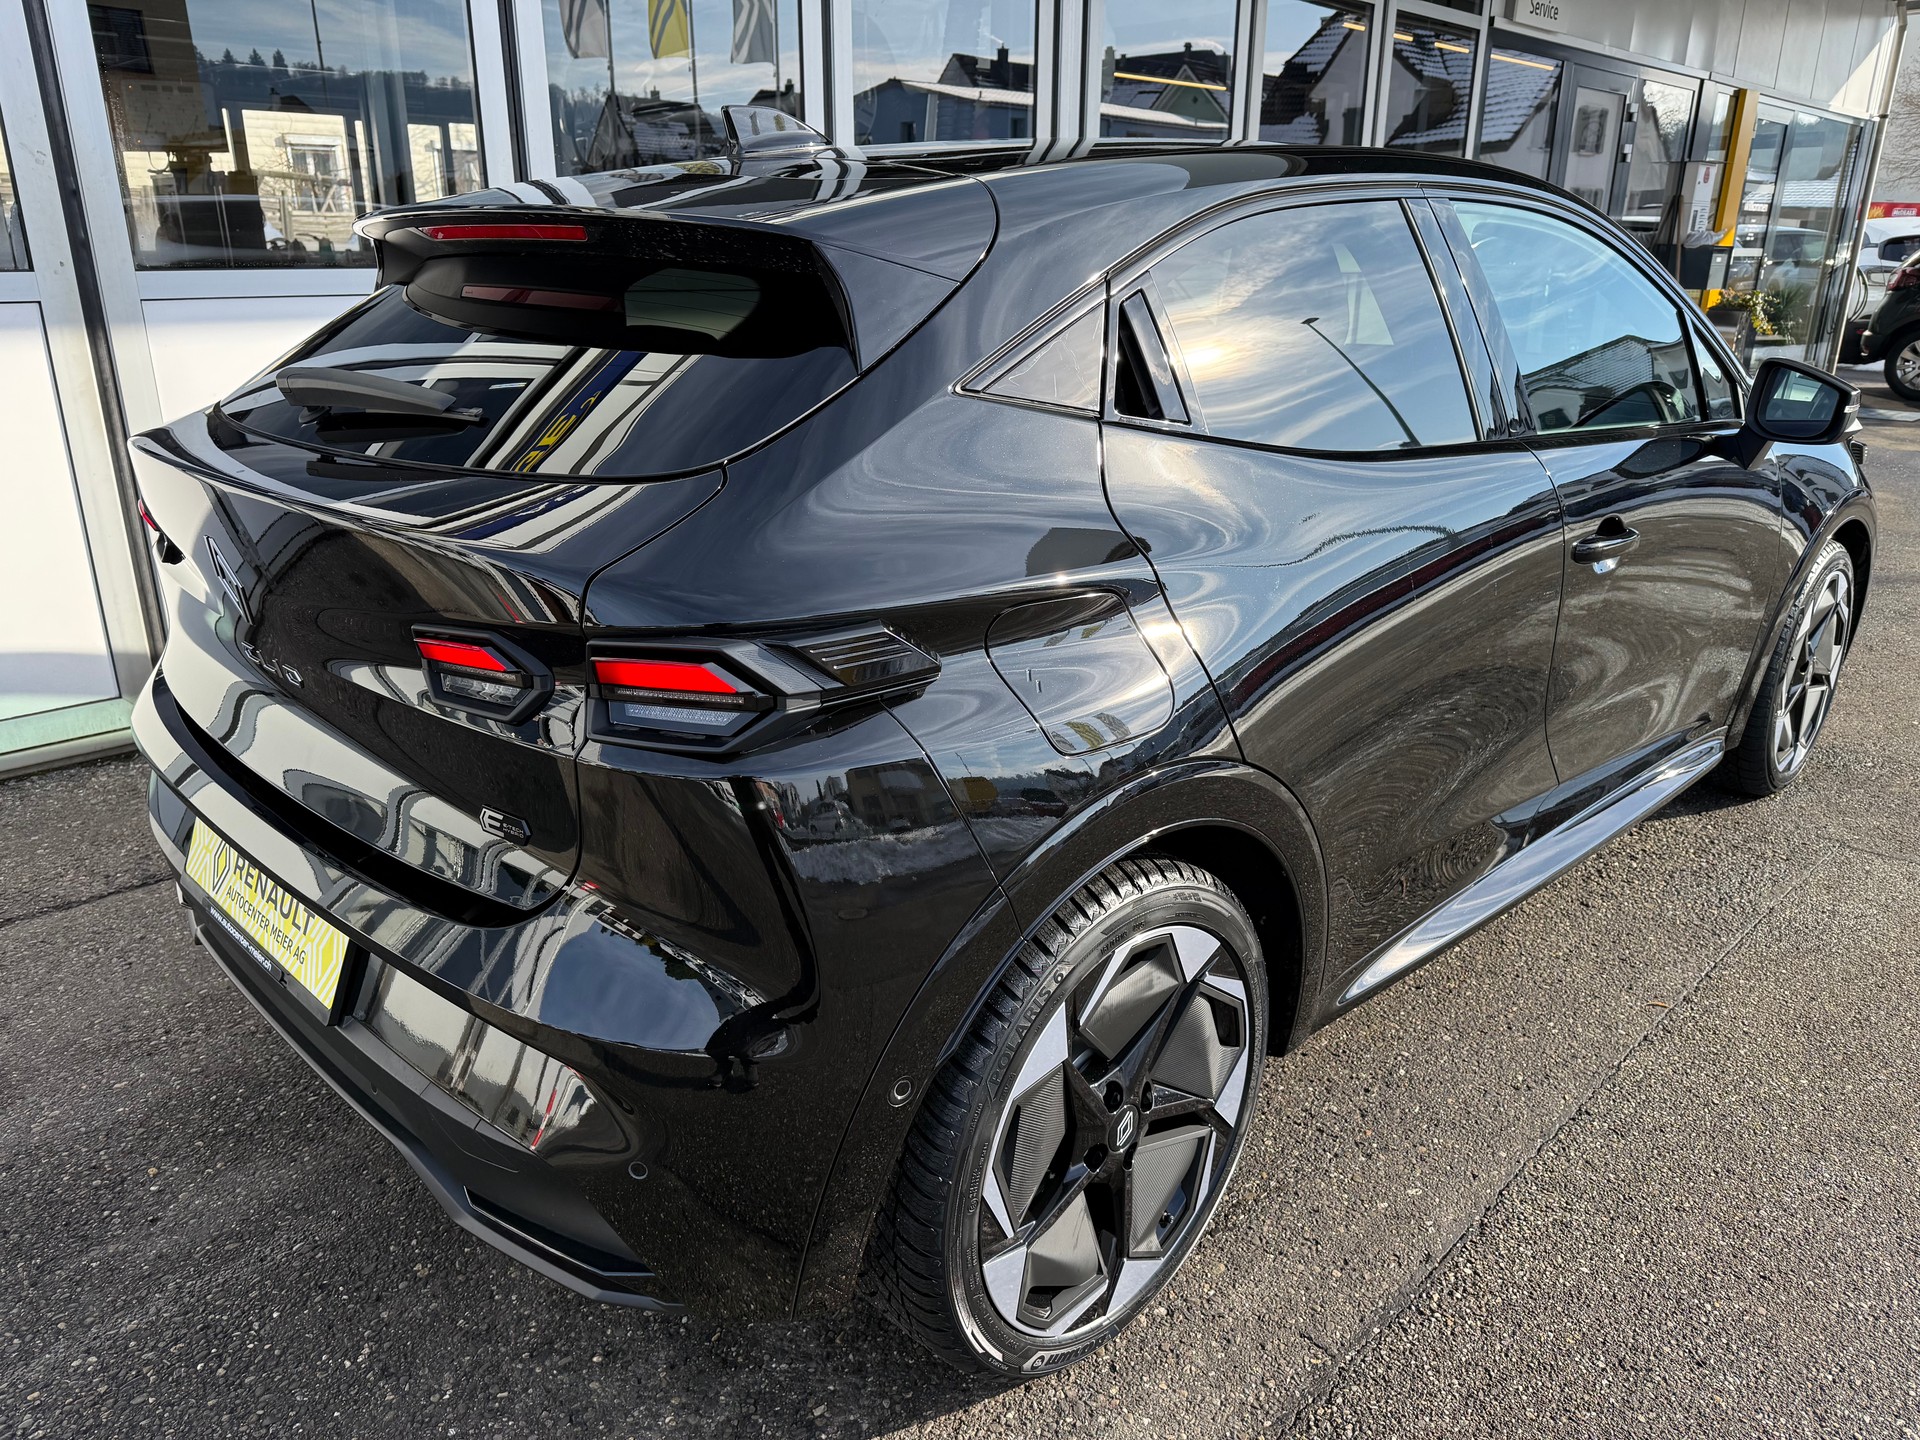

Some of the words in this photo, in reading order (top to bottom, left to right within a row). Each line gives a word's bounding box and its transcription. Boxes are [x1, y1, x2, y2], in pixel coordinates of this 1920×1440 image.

[1529, 0, 1559, 20] Service
[226, 885, 271, 930] AUTOCENTER
[270, 924, 294, 955] MEIER
[293, 945, 307, 965] AG
[233, 855, 316, 936] RENAULT
[210, 906, 272, 972] www.autocenter-meier.ch
[991, 986, 1052, 1085] POLARIS
[1053, 971, 1065, 985] 6
